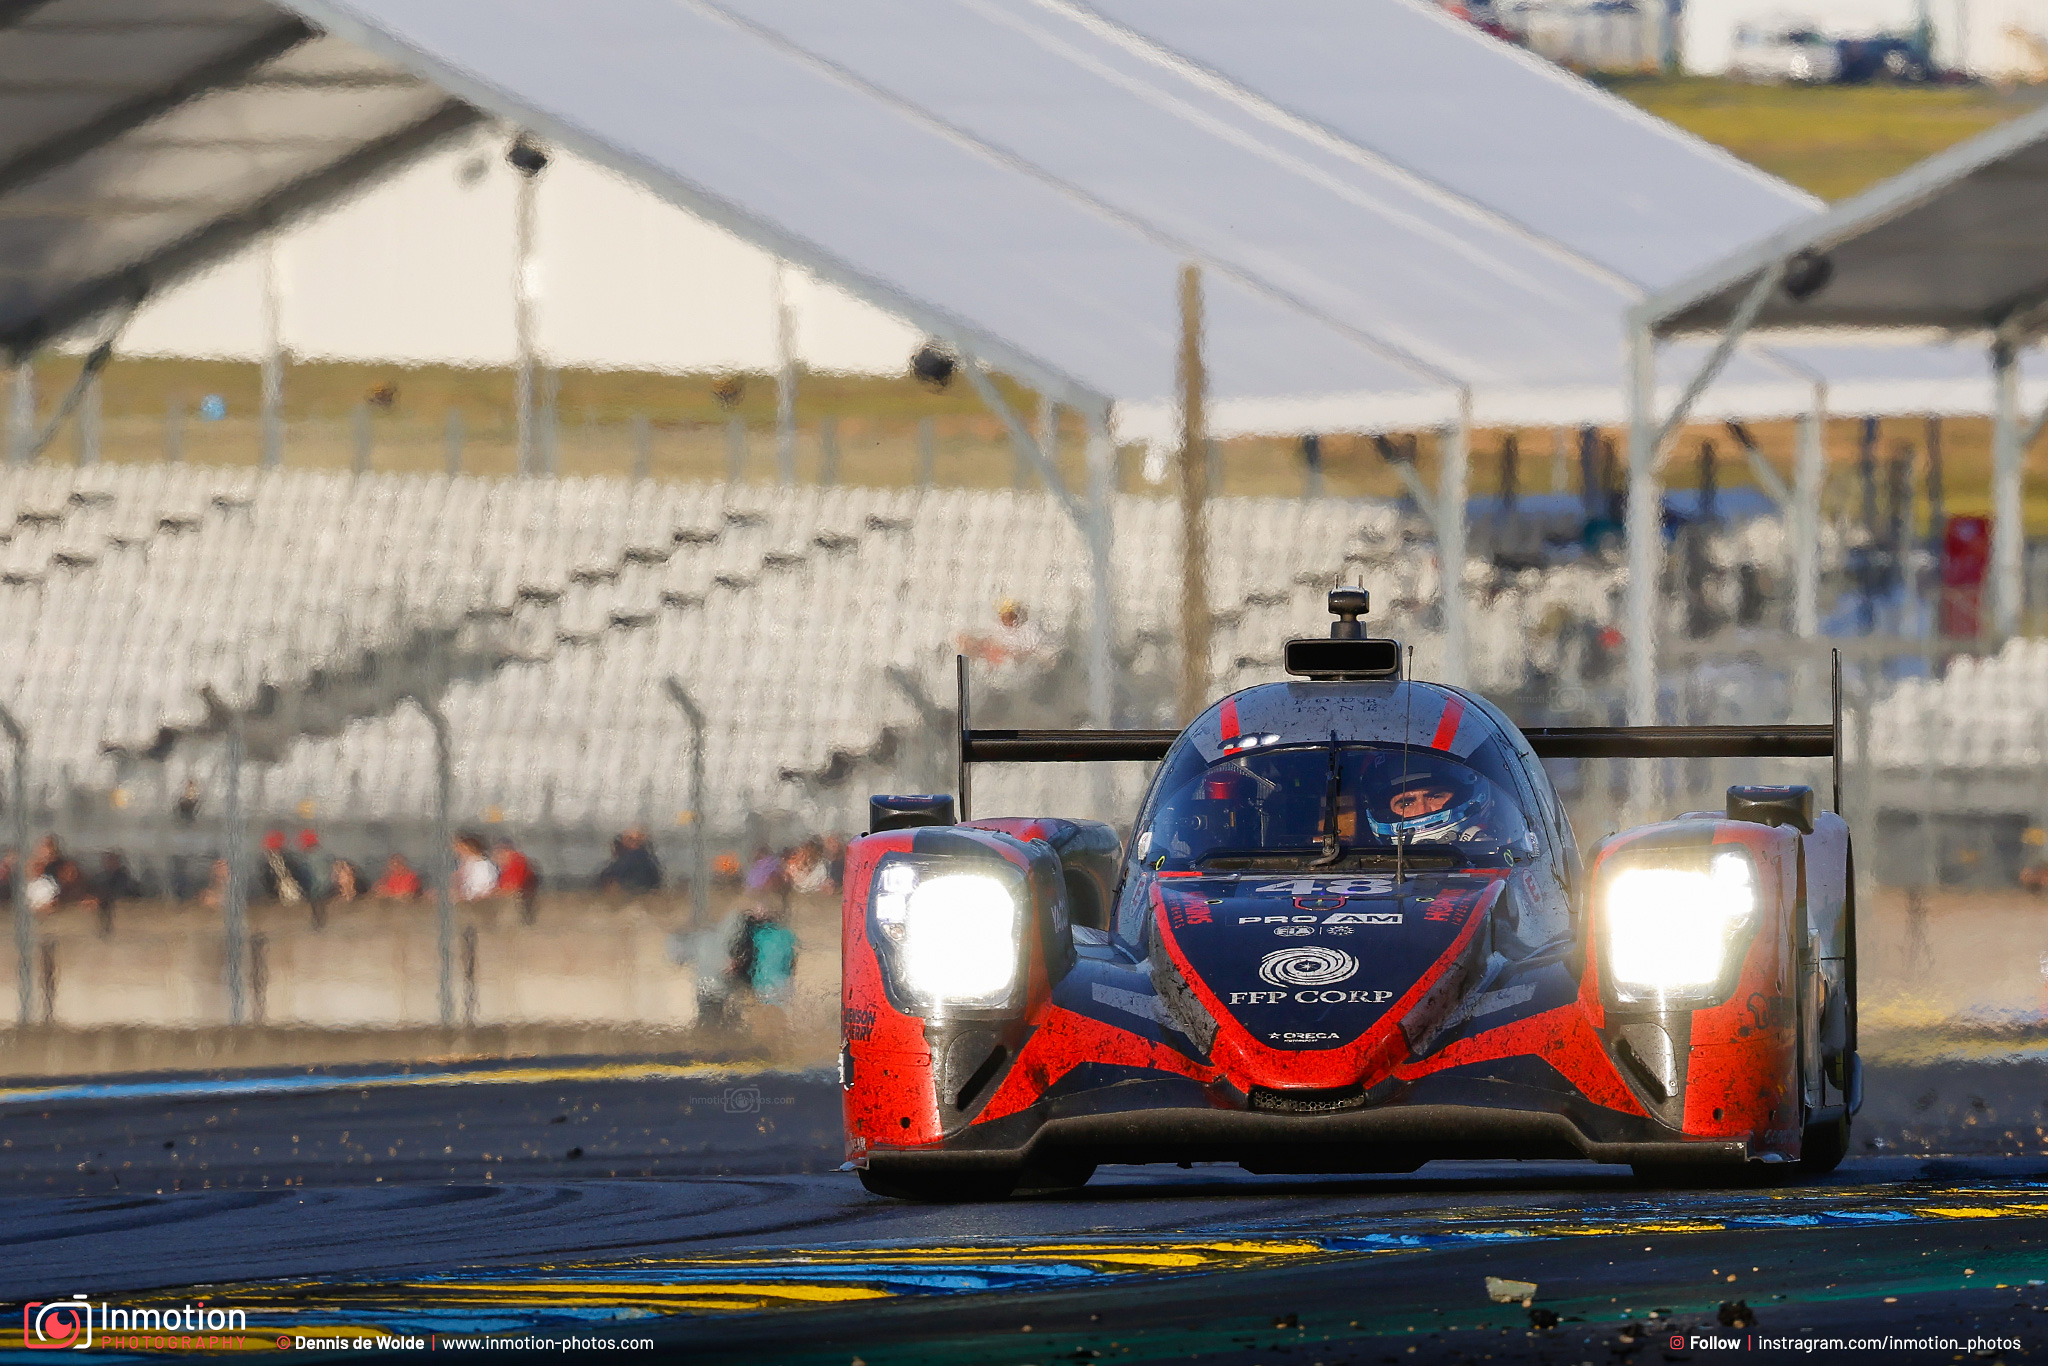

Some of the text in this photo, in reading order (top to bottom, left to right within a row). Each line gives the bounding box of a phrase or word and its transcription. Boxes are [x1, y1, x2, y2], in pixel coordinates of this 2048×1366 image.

[1255, 879, 1393, 895] 48
[1238, 914, 1400, 925] PRO AM
[1228, 990, 1394, 1004] FFP CORP
